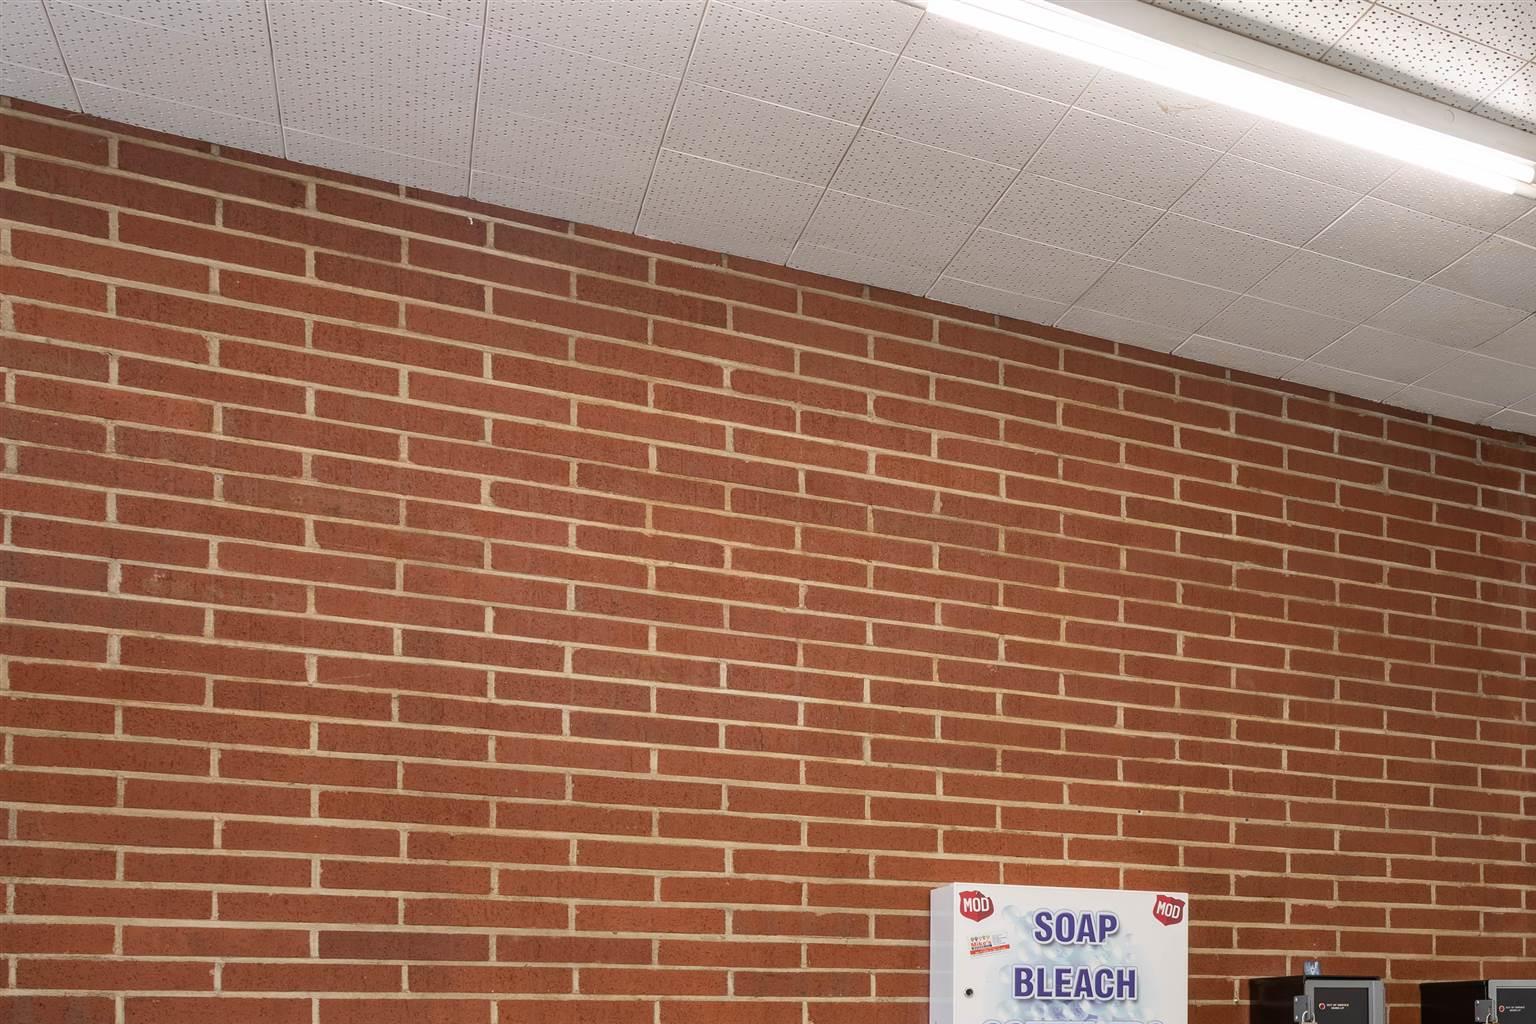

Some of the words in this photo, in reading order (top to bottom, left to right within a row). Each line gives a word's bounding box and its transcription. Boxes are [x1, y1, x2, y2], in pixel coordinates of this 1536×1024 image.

[963, 897, 990, 913] MOD
[1156, 900, 1181, 919] MOD
[1034, 911, 1118, 943] SOAP
[1013, 967, 1136, 998] BLEACH
